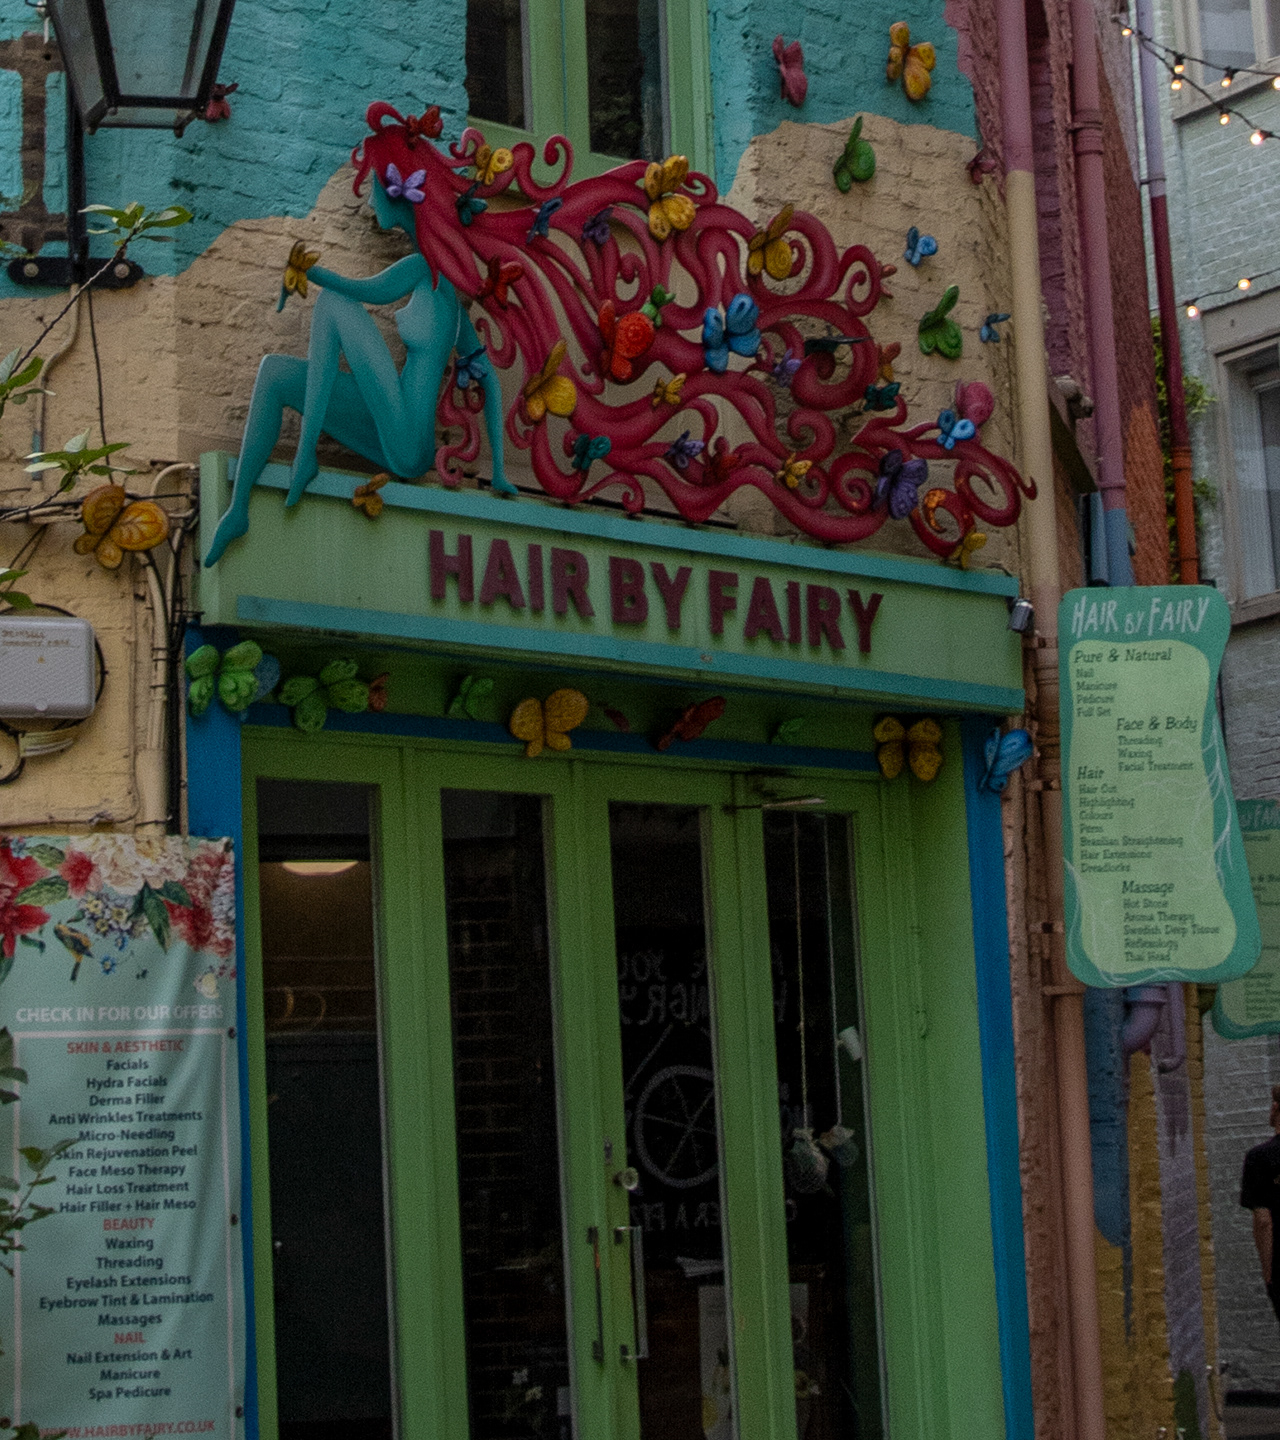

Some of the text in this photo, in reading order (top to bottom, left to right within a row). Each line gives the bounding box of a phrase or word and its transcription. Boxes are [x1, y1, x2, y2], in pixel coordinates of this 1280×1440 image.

[428, 529, 884, 655] HAIR BY FAIRY
[1072, 595, 1118, 638] HAIR
[1148, 597, 1210, 636] FAIRY
[1074, 648, 1172, 663] Pure & Natural
[1076, 669, 1094, 678] Nail
[1076, 682, 1117, 691] Manicure
[1076, 695, 1114, 704] Pedicure
[1096, 708, 1111, 716] Set
[1117, 716, 1198, 733] Face & Body
[1118, 736, 1163, 747] Threading
[1118, 749, 1152, 759] Waxing
[1118, 761, 1193, 771] Facial Treatment
[1077, 766, 1104, 780] Hair
[1079, 785, 1098, 794] Hair
[1079, 798, 1134, 808] Highlighting
[1122, 837, 1183, 848] Straightening
[1081, 851, 1099, 860] Hair
[1122, 881, 1174, 896] Massage
[1124, 900, 1139, 908] Hot
[1157, 912, 1194, 923] Therapy
[16, 1005, 223, 1022] CHECK IN FOR OUR OFFERS
[67, 1040, 184, 1054] SKIN & AESTHETIC
[106, 1059, 148, 1070] Facials
[87, 1075, 167, 1089] Hydra Facials
[90, 1094, 165, 1106] Derma Filler
[49, 1111, 202, 1125] Anti Wrinkles Treatments
[78, 1129, 175, 1142] Micro-Needling
[56, 1146, 197, 1161] Skin Rejuvenation Peel
[69, 1164, 186, 1177] Face Meso Therapy
[66, 1182, 189, 1195] Hair Loss Treatment
[60, 1202, 86, 1213] Hair
[90, 1201, 121, 1212] Filler
[136, 1199, 159, 1211] Hair
[163, 1199, 196, 1210] Meso
[103, 1218, 155, 1231] BEAUTY
[105, 1238, 154, 1251] Waxing
[96, 1256, 163, 1270] Threading
[67, 1274, 191, 1291] Eyelash Extensions
[40, 1292, 213, 1311] Eyebrow Tint & Lamination
[98, 1313, 162, 1327] Massages
[114, 1332, 146, 1344] NAIL
[67, 1348, 193, 1364] Nail Extension & Art
[101, 1369, 160, 1381] Manicure
[89, 1386, 171, 1401] Spa Pedicure
